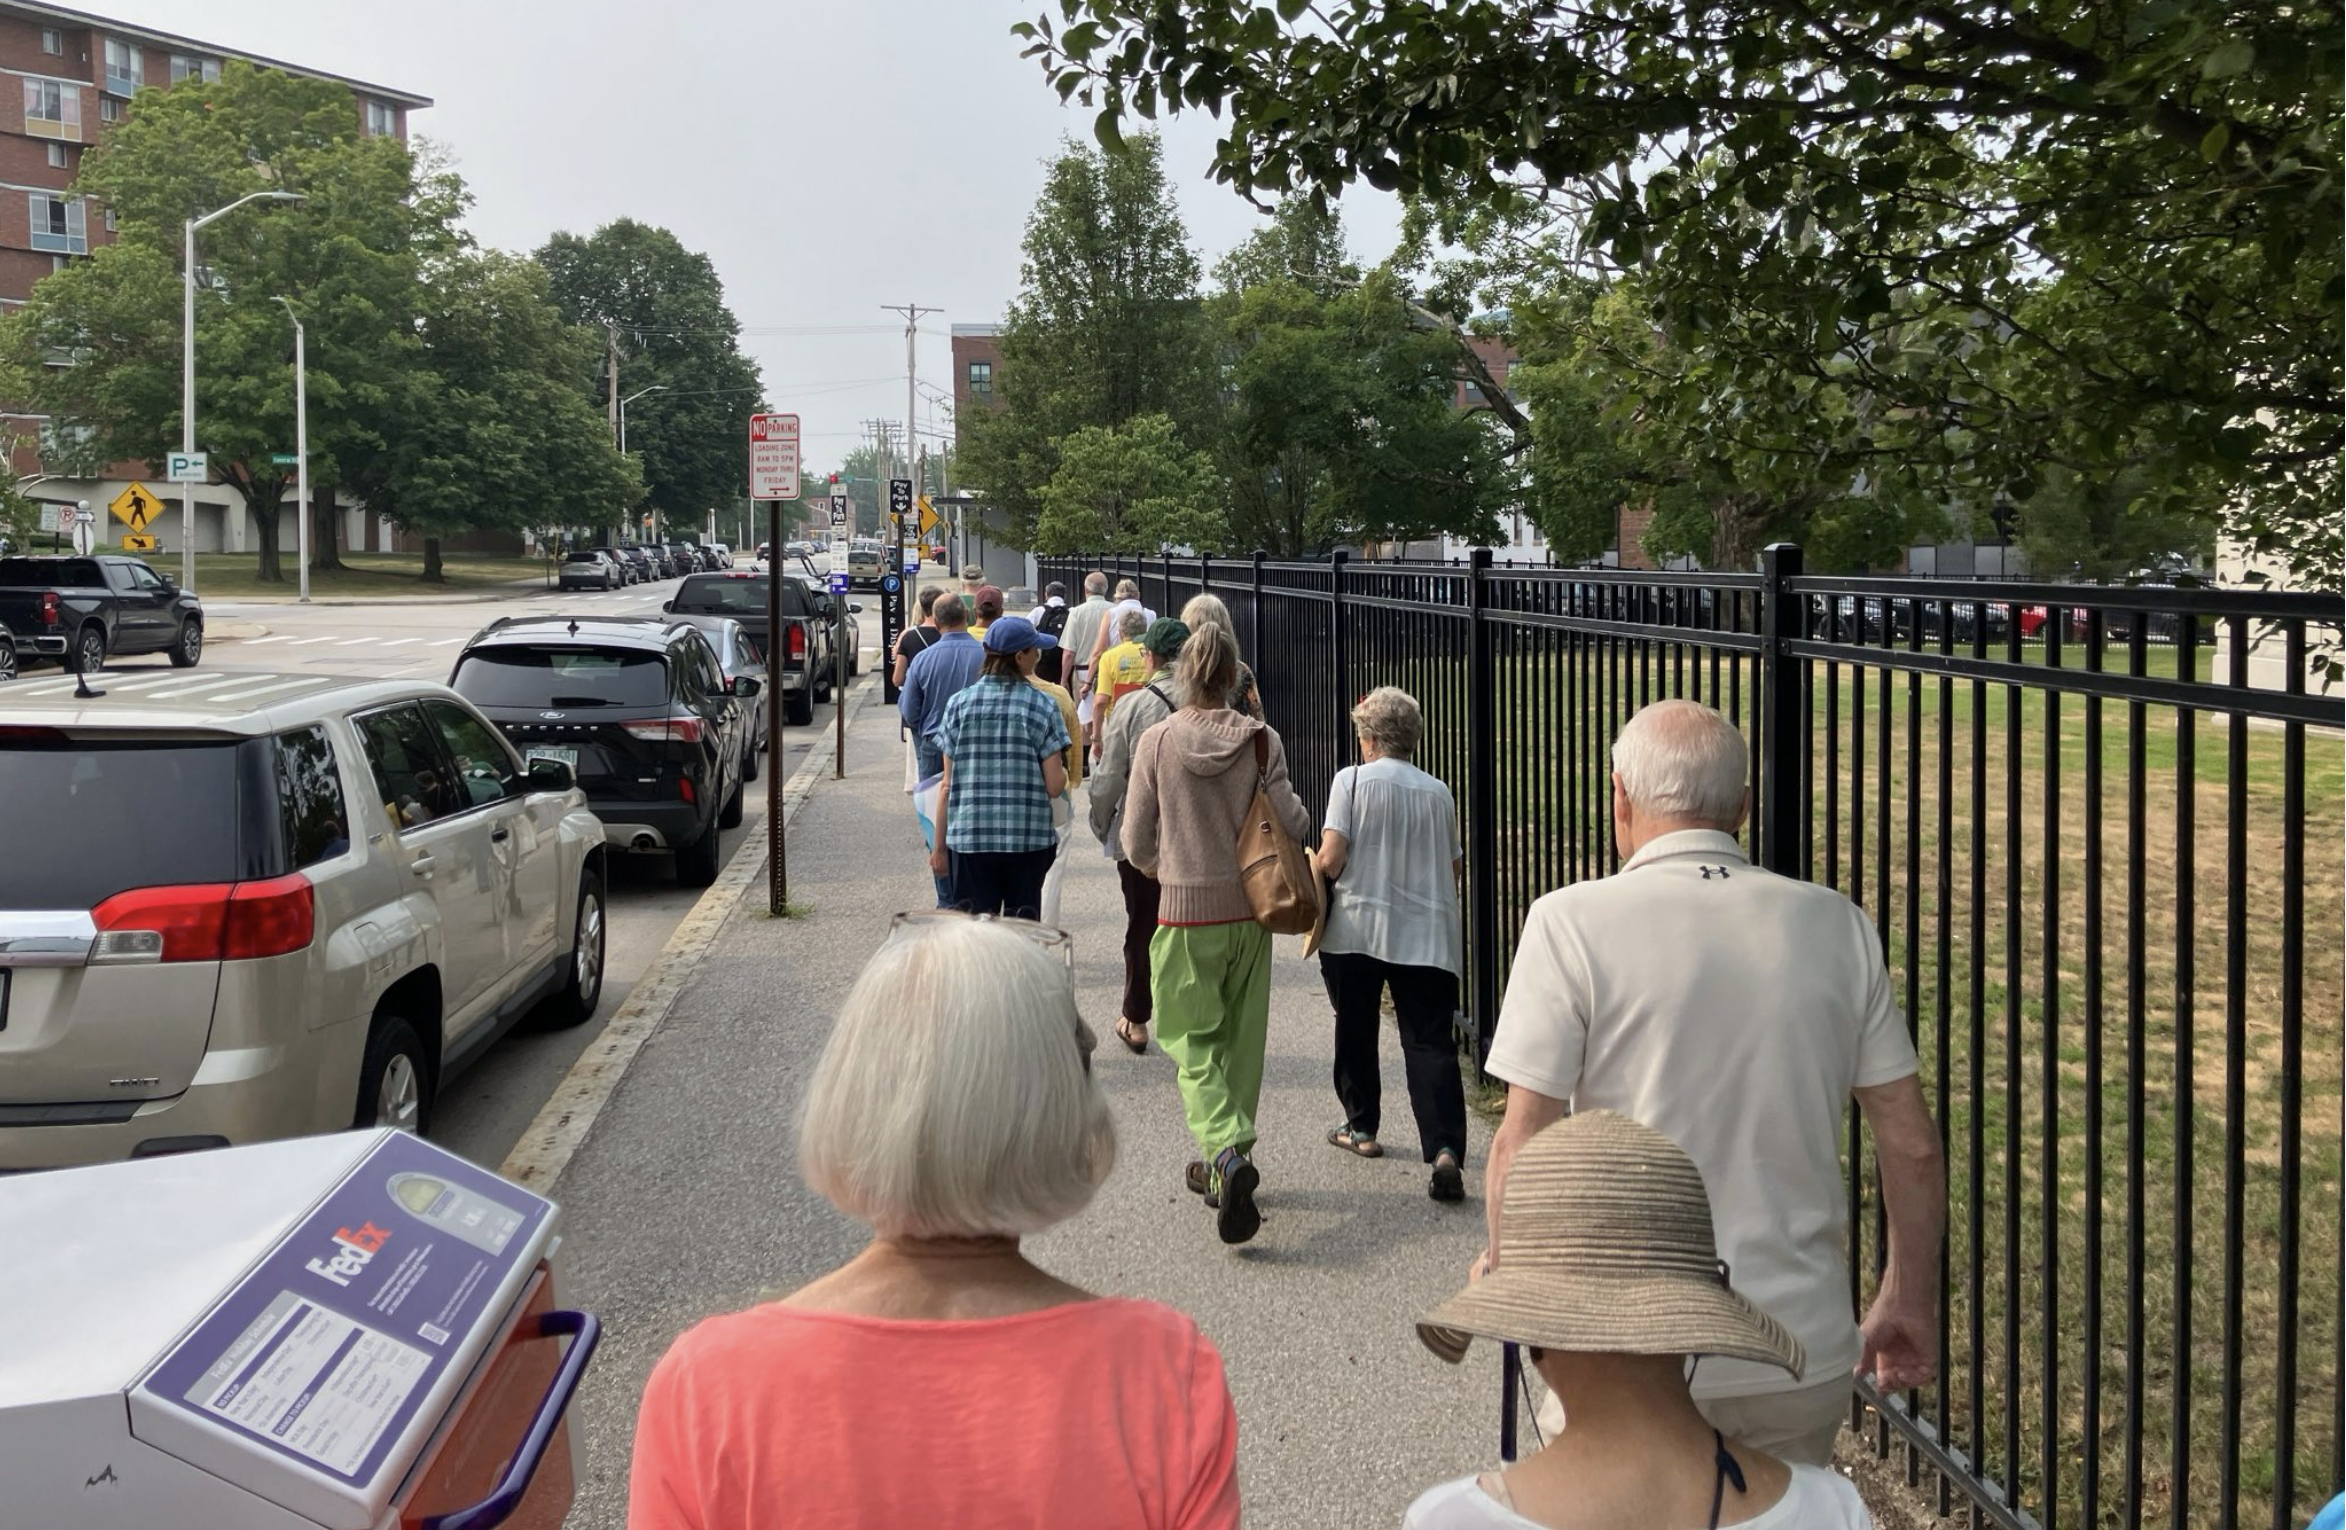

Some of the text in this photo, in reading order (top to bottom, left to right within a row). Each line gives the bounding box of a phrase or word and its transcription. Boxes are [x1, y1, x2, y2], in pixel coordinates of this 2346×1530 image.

[753, 420, 796, 436] NO PARKING
[755, 444, 779, 452] LOADING
[834, 497, 844, 506] Pay
[833, 512, 845, 520] Park
[890, 596, 898, 613] Pay
[888, 629, 898, 665] Dispay
[305, 1220, 392, 1287] FedEx
